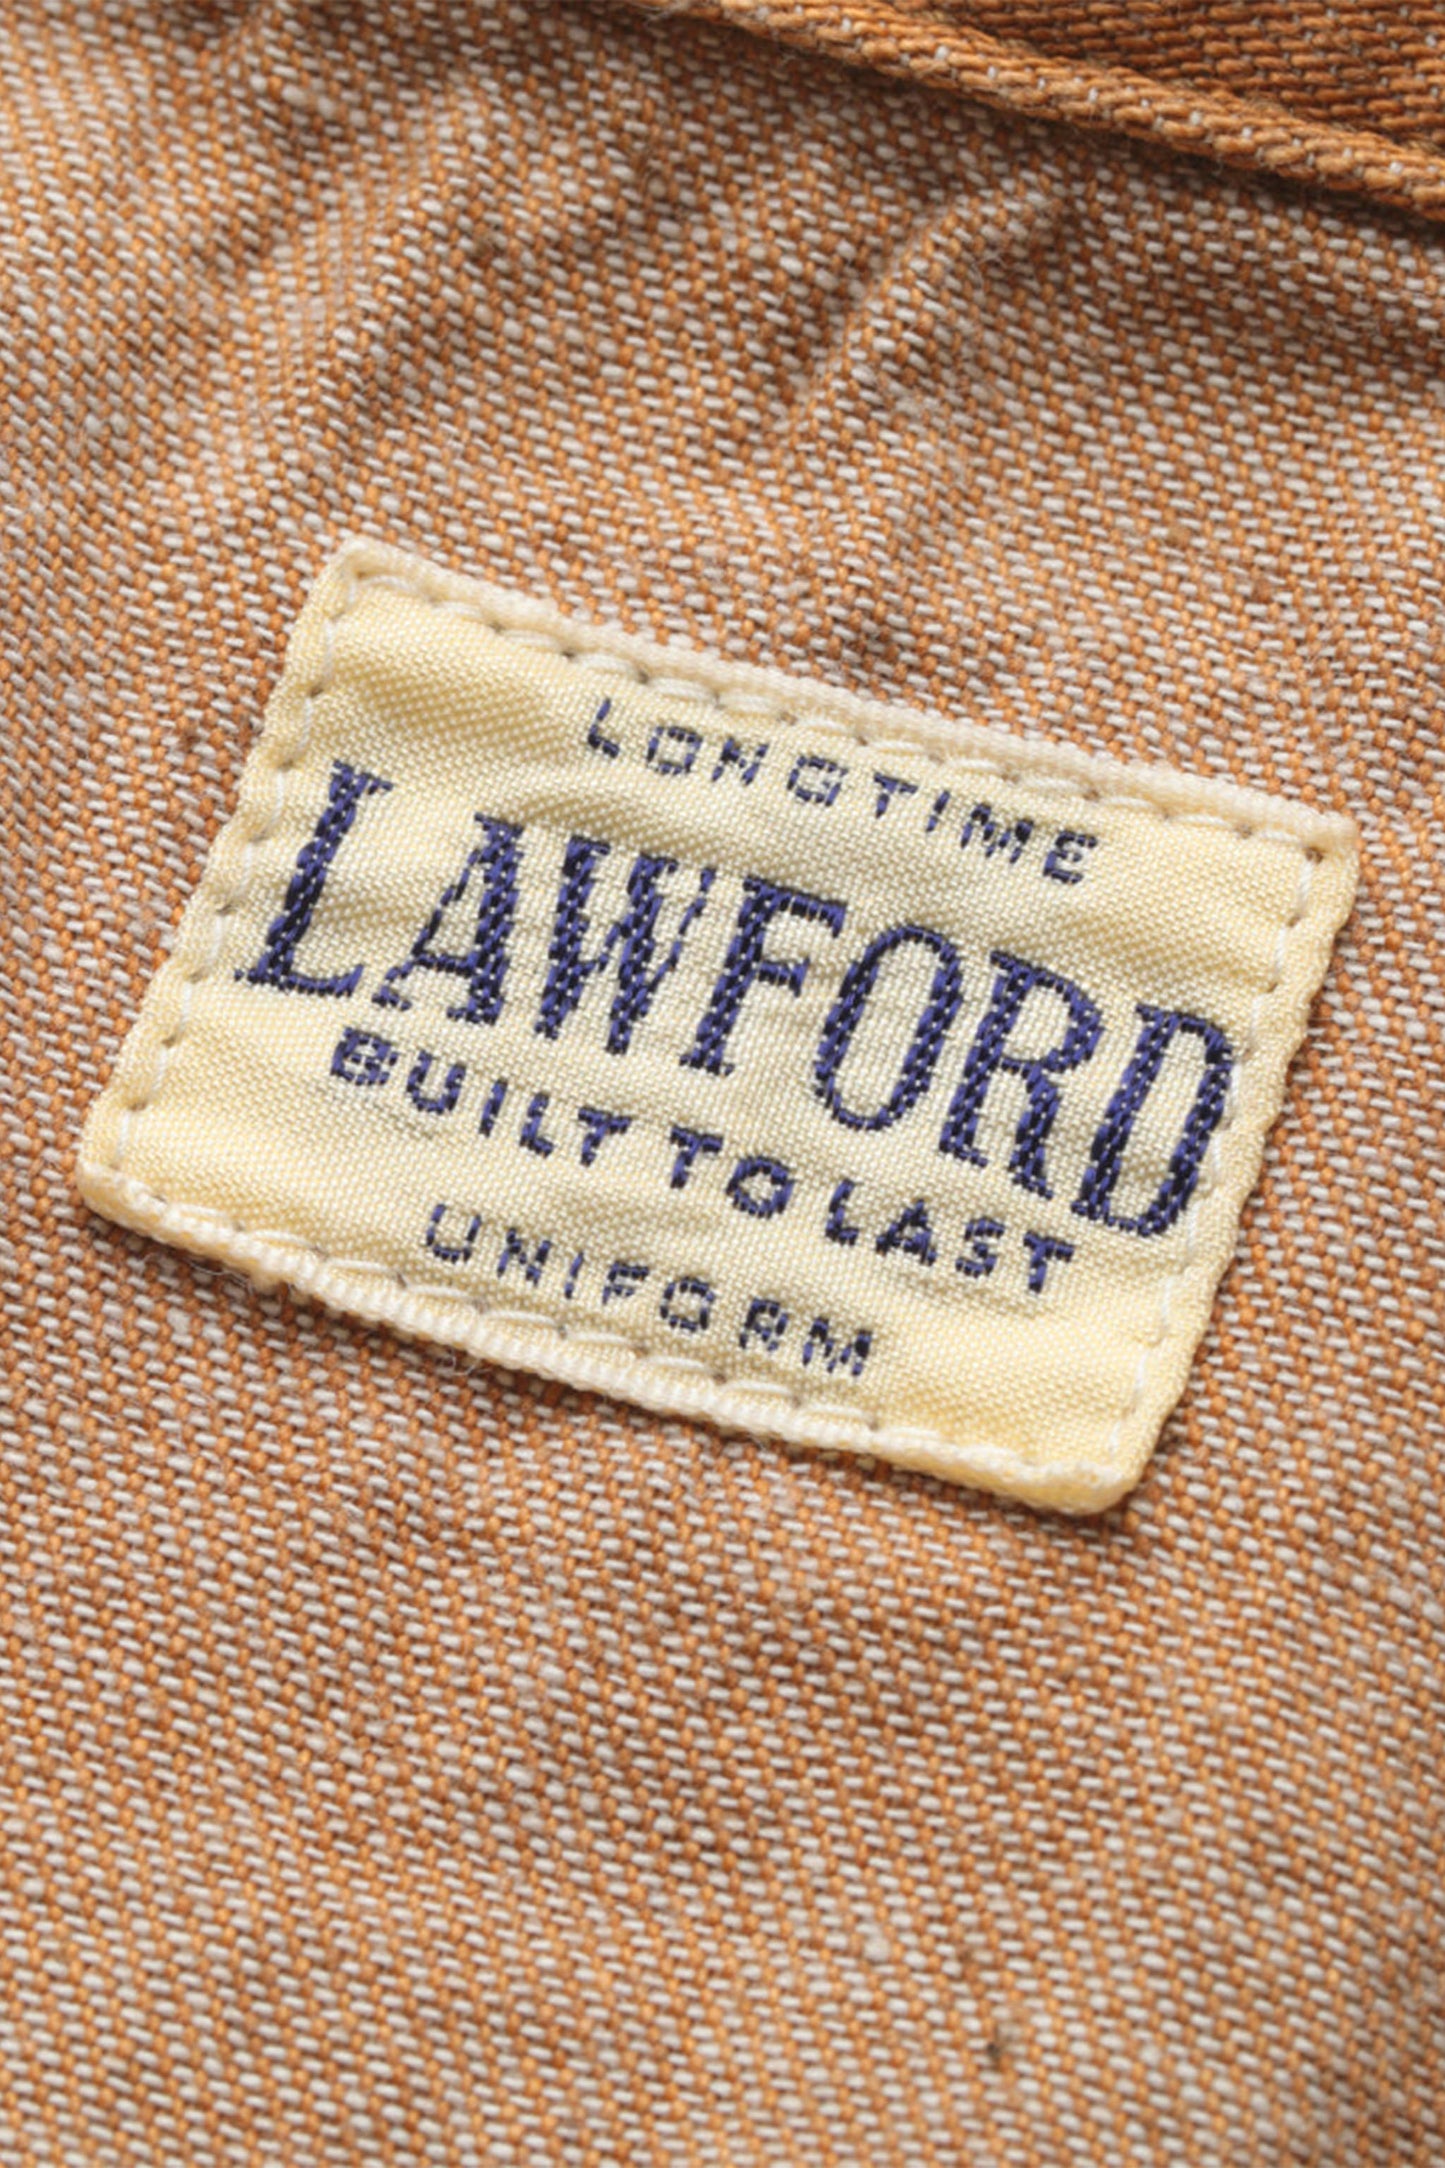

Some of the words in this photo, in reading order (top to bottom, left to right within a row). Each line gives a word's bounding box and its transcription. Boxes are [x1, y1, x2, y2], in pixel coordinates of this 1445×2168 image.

[588, 699, 1099, 886] LONGTIME
[234, 759, 1235, 1238] LAWFORD
[330, 1026, 632, 1166] BUILT
[669, 1125, 795, 1218] TO
[825, 1179, 1075, 1293] LAST
[425, 1203, 873, 1377] UNIFORM
